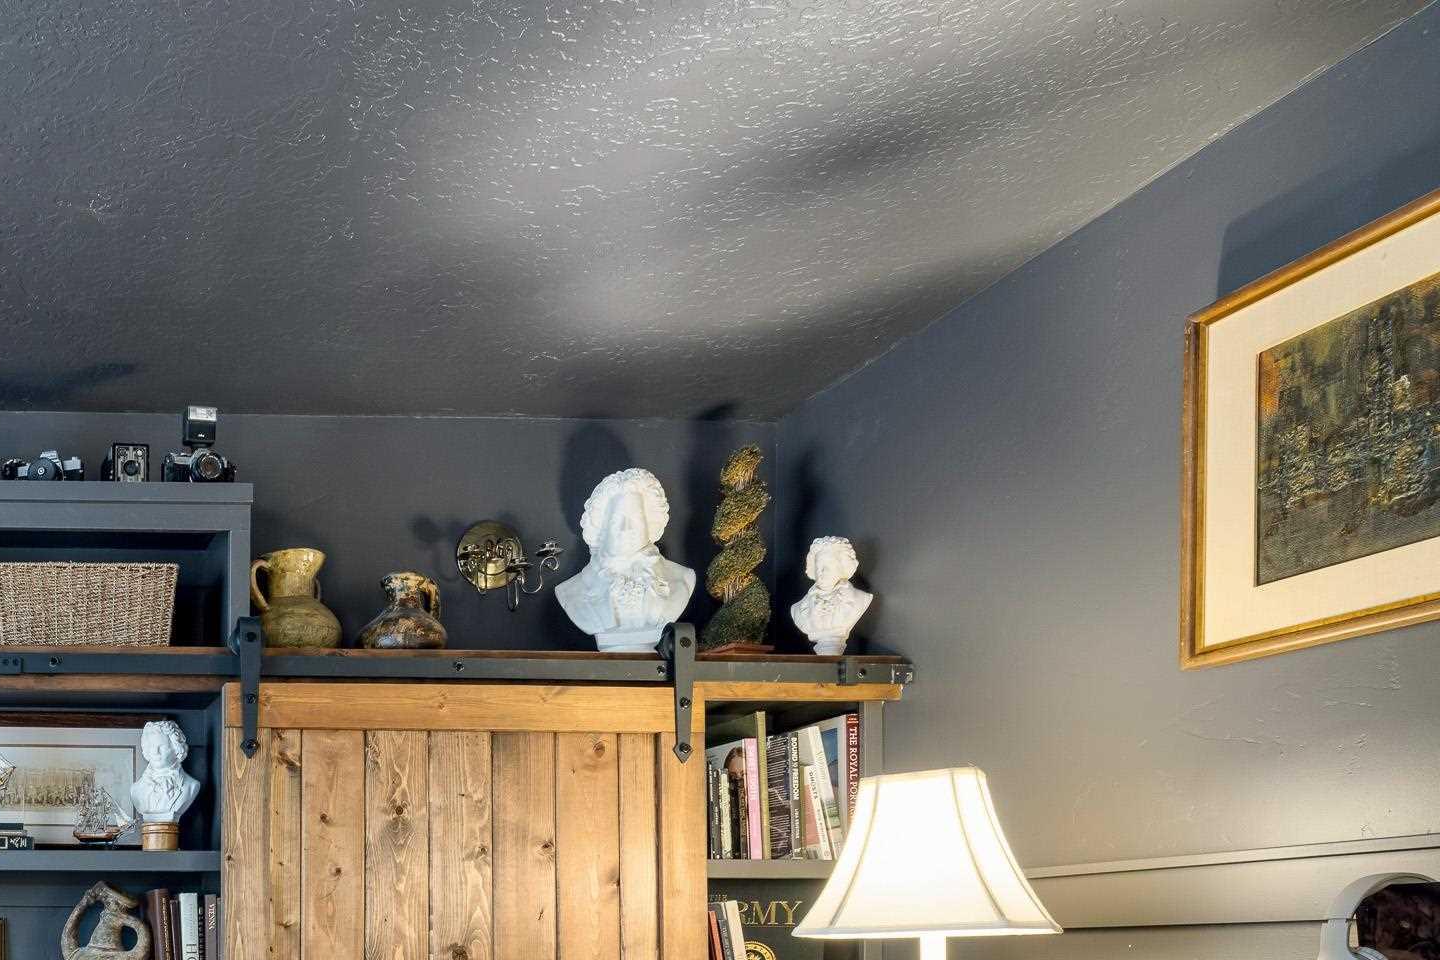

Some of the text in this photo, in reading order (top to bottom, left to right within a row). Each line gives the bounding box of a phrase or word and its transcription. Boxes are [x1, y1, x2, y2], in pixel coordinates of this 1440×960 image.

[790, 737, 798, 762] BOUND
[849, 727, 858, 746] THE
[849, 747, 858, 780] ROYAL
[792, 768, 800, 800] FREEDOM
[208, 903, 216, 930] VIENNA
[737, 900, 802, 925] RMY
